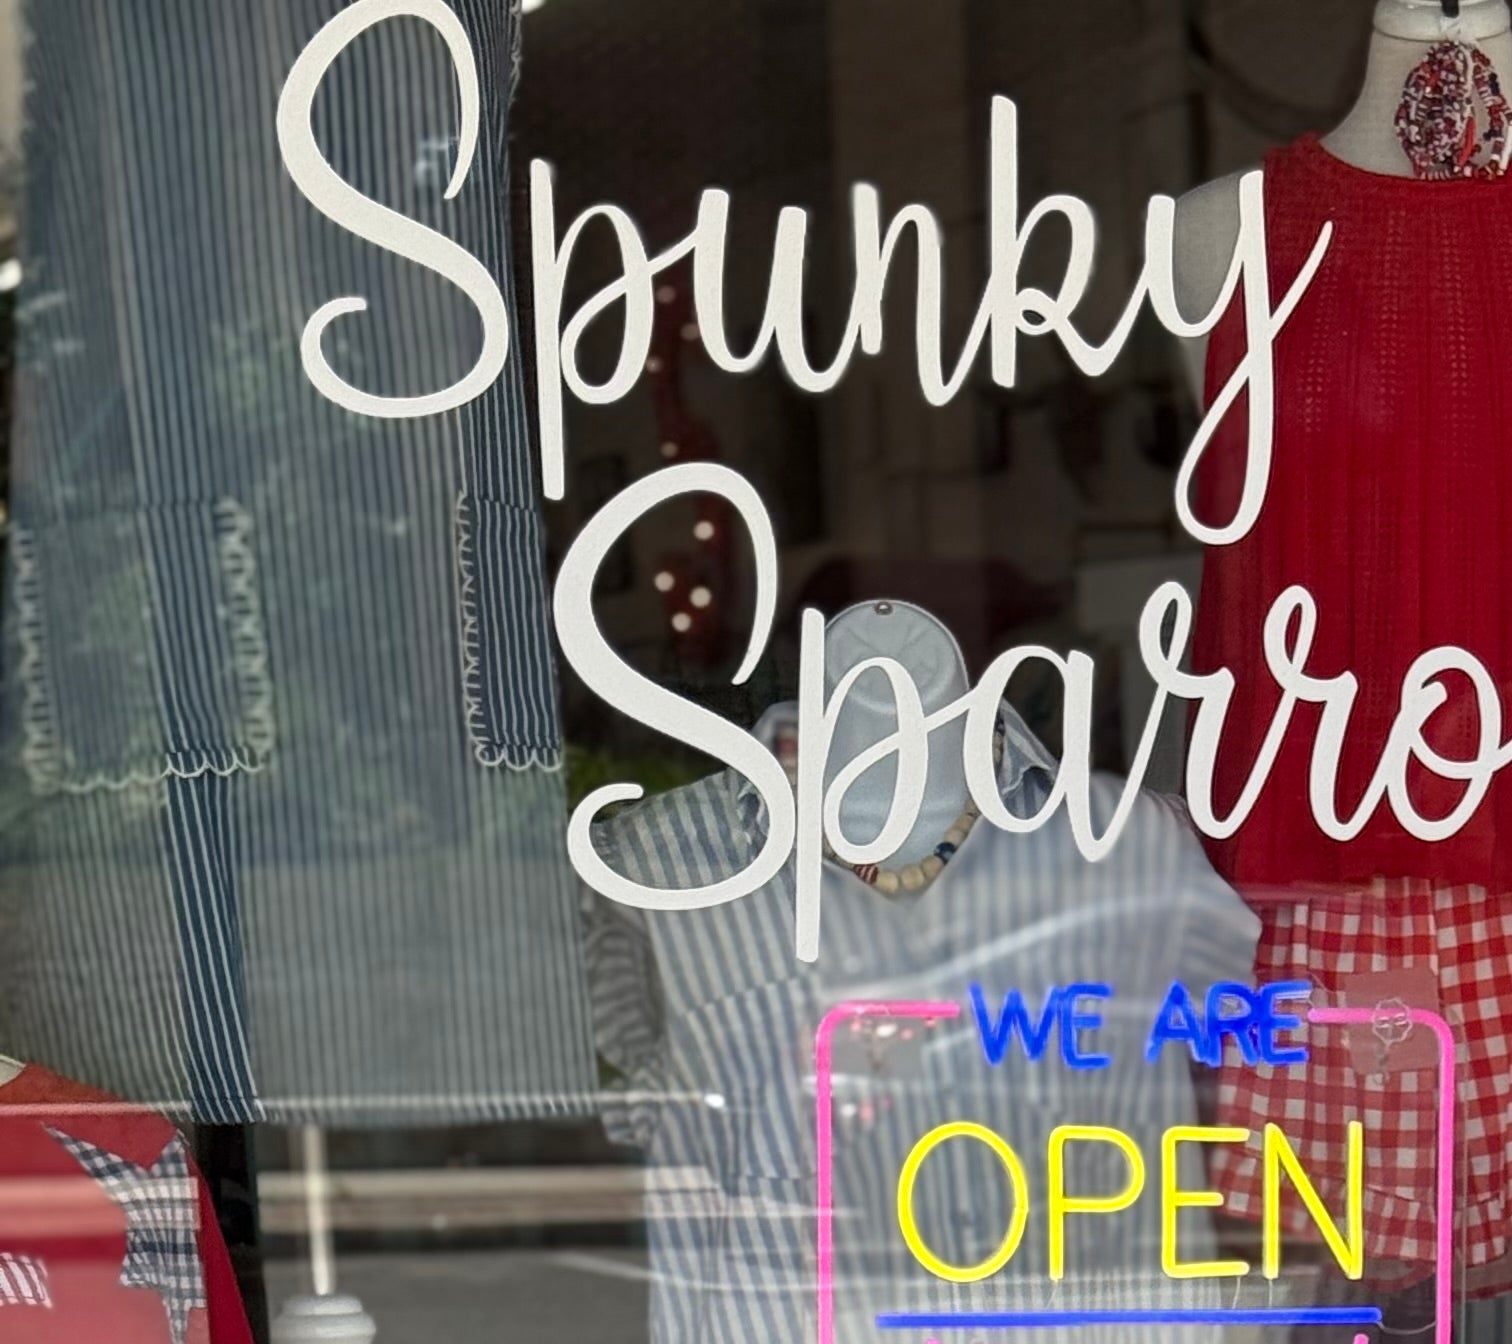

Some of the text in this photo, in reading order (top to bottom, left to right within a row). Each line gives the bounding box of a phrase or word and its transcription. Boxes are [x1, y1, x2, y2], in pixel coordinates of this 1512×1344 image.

[276, 0, 1333, 545] Spunky
[968, 980, 1312, 1069] WE ARE
[897, 1120, 1364, 1283] OPEN
